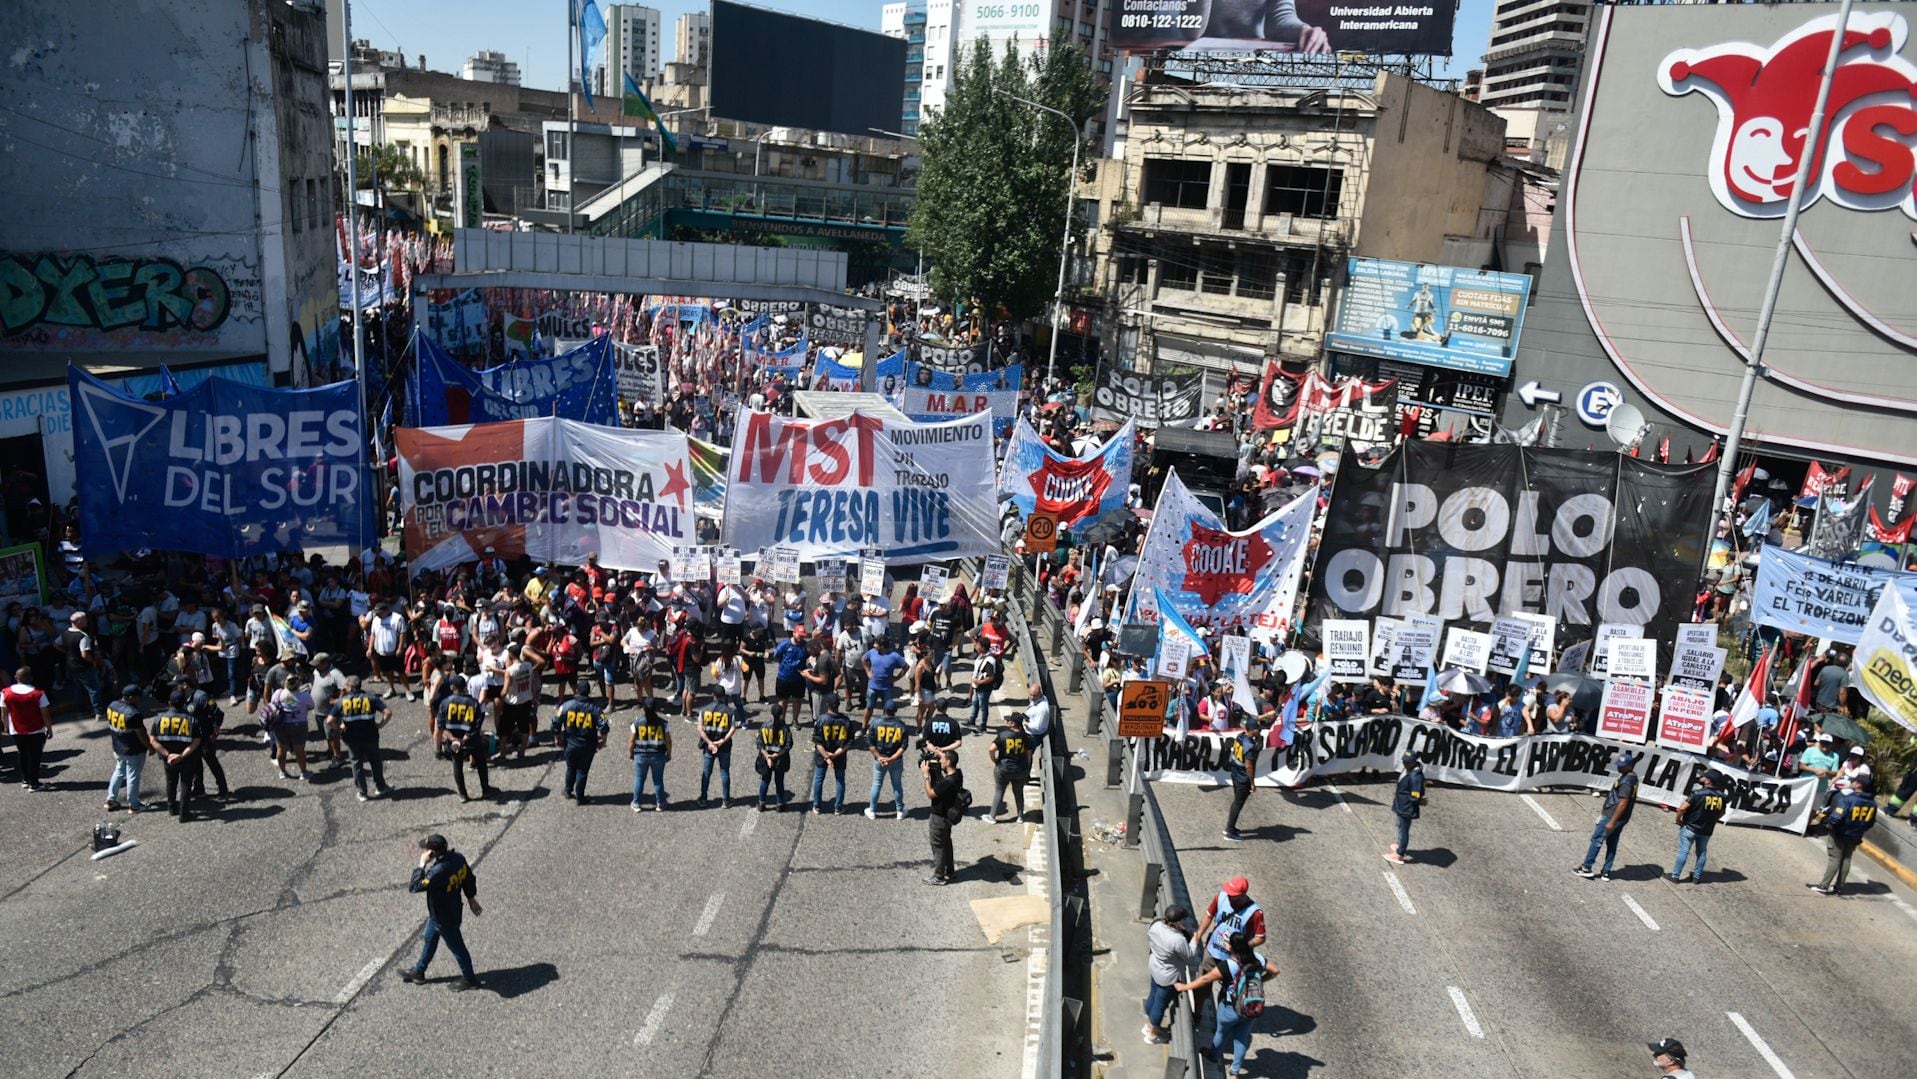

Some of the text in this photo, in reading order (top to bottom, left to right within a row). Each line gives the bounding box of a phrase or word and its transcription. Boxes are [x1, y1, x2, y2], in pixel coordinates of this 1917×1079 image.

[976, 4, 1040, 18] 5066-9100
[1330, 6, 1434, 17] Universidad Abierta
[1121, 14, 1202, 28] 0810-122-1222
[1340, 19, 1418, 30] Interamericana
[1832, 105, 1917, 195] S
[732, 219, 886, 241] BIENVENIDOS A AVELLANEDA
[741, 300, 800, 312] OBRERO
[1458, 292, 1512, 304] CUOTAS FIJAS
[538, 316, 590, 338] MULCS
[1448, 323, 1509, 338] 11-6016-7096
[1490, 318, 1506, 327] SMS
[920, 345, 973, 366] POLO
[480, 350, 596, 404] LIBRES
[1110, 369, 1179, 398] POLO
[0, 391, 70, 420] RACIAS
[1097, 386, 1190, 418] OBRERO
[168, 409, 360, 465] LIBRES
[891, 424, 982, 446] MOVIMIENTO
[739, 412, 884, 487] MST
[164, 462, 359, 515] DEL SUR
[412, 460, 656, 506] COORDINADORA
[1044, 472, 1094, 503] COOKE
[416, 503, 444, 523] POR
[576, 494, 684, 538] SOCIAL
[774, 488, 950, 545] TERESA VIVE
[1386, 482, 1615, 558] POLO
[429, 520, 444, 538] EL
[1034, 522, 1050, 534] 20
[1324, 548, 1661, 626] OBRERO
[1803, 571, 1871, 592] 12 DE ABRIL
[1815, 586, 1861, 608] VARELA
[1772, 596, 1866, 628] EL TROPEZON
[1220, 612, 1290, 632] LA TEJA
[1330, 630, 1363, 642] TRABAJO
[1330, 642, 1363, 655] GENUINO
[1686, 650, 1714, 659] SALARIO
[1682, 655, 1700, 664] IGUAL
[1682, 662, 1711, 672] CANASTA
[1612, 686, 1646, 695] ASAMBLEA
[1680, 678, 1704, 686] POLO
[342, 696, 371, 716] PFA
[1670, 695, 1705, 705] ABAJO
[106, 707, 128, 730] PFA
[447, 703, 475, 723] PFA
[566, 710, 592, 729] PFA
[704, 710, 729, 728] PFA
[1607, 711, 1643, 721] ATraPer
[1680, 707, 1702, 716] PERU
[160, 716, 190, 736] PFA
[638, 724, 664, 741] PFA
[822, 724, 847, 742] PFA
[876, 725, 902, 744] PFA
[932, 722, 950, 734] PFA
[1665, 719, 1703, 731] ATraPer
[1144, 734, 1234, 772] TRABAJO
[1318, 716, 1402, 764] SALARIO
[1408, 724, 1486, 771] CONTRA
[1492, 743, 1519, 776] EL
[1642, 754, 1682, 792] LA
[1704, 796, 1723, 812] PFA
[1852, 806, 1876, 822] PFA
